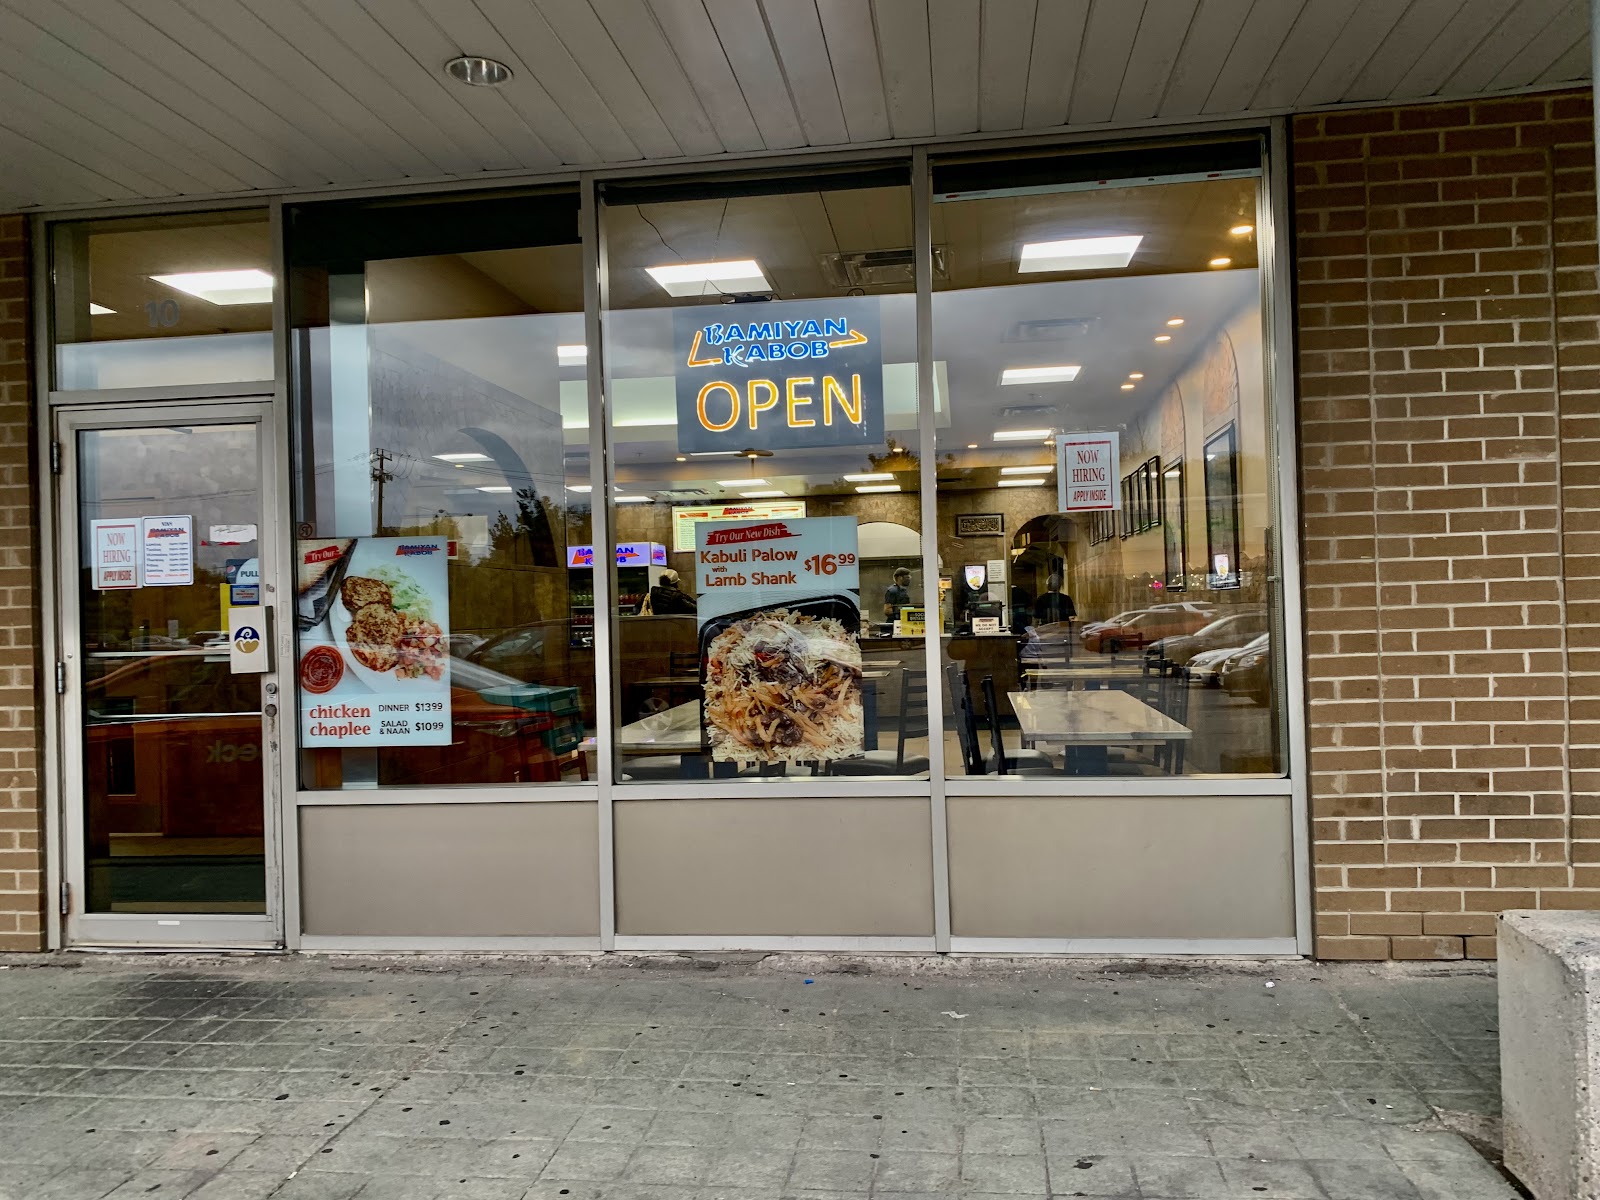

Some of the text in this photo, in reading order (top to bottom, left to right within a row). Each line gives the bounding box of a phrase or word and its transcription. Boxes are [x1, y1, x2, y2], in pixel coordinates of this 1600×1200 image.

[145, 299, 179, 327] 10
[704, 317, 847, 345] BAMIYAN
[722, 340, 830, 367] KABOB
[696, 373, 863, 432] OPEN
[1077, 450, 1099, 464] NOW
[1072, 468, 1105, 482] HIRING
[1073, 490, 1106, 502] APPLY INSIDE
[107, 533, 125, 546] NOW
[715, 526, 781, 543] Try Our New Dish
[103, 550, 130, 563] HIRING
[311, 550, 335, 562] Try Our
[701, 547, 798, 564] Kabuli Palow
[103, 571, 117, 581] APPLY
[240, 570, 259, 578] PULL
[712, 565, 728, 573] with
[705, 571, 797, 587] Lamb Shank
[309, 704, 371, 719] chicken
[378, 704, 410, 712] DINNER
[309, 721, 371, 739] chaplee
[379, 727, 411, 735] & NAAN
[380, 720, 409, 728] SALAD
